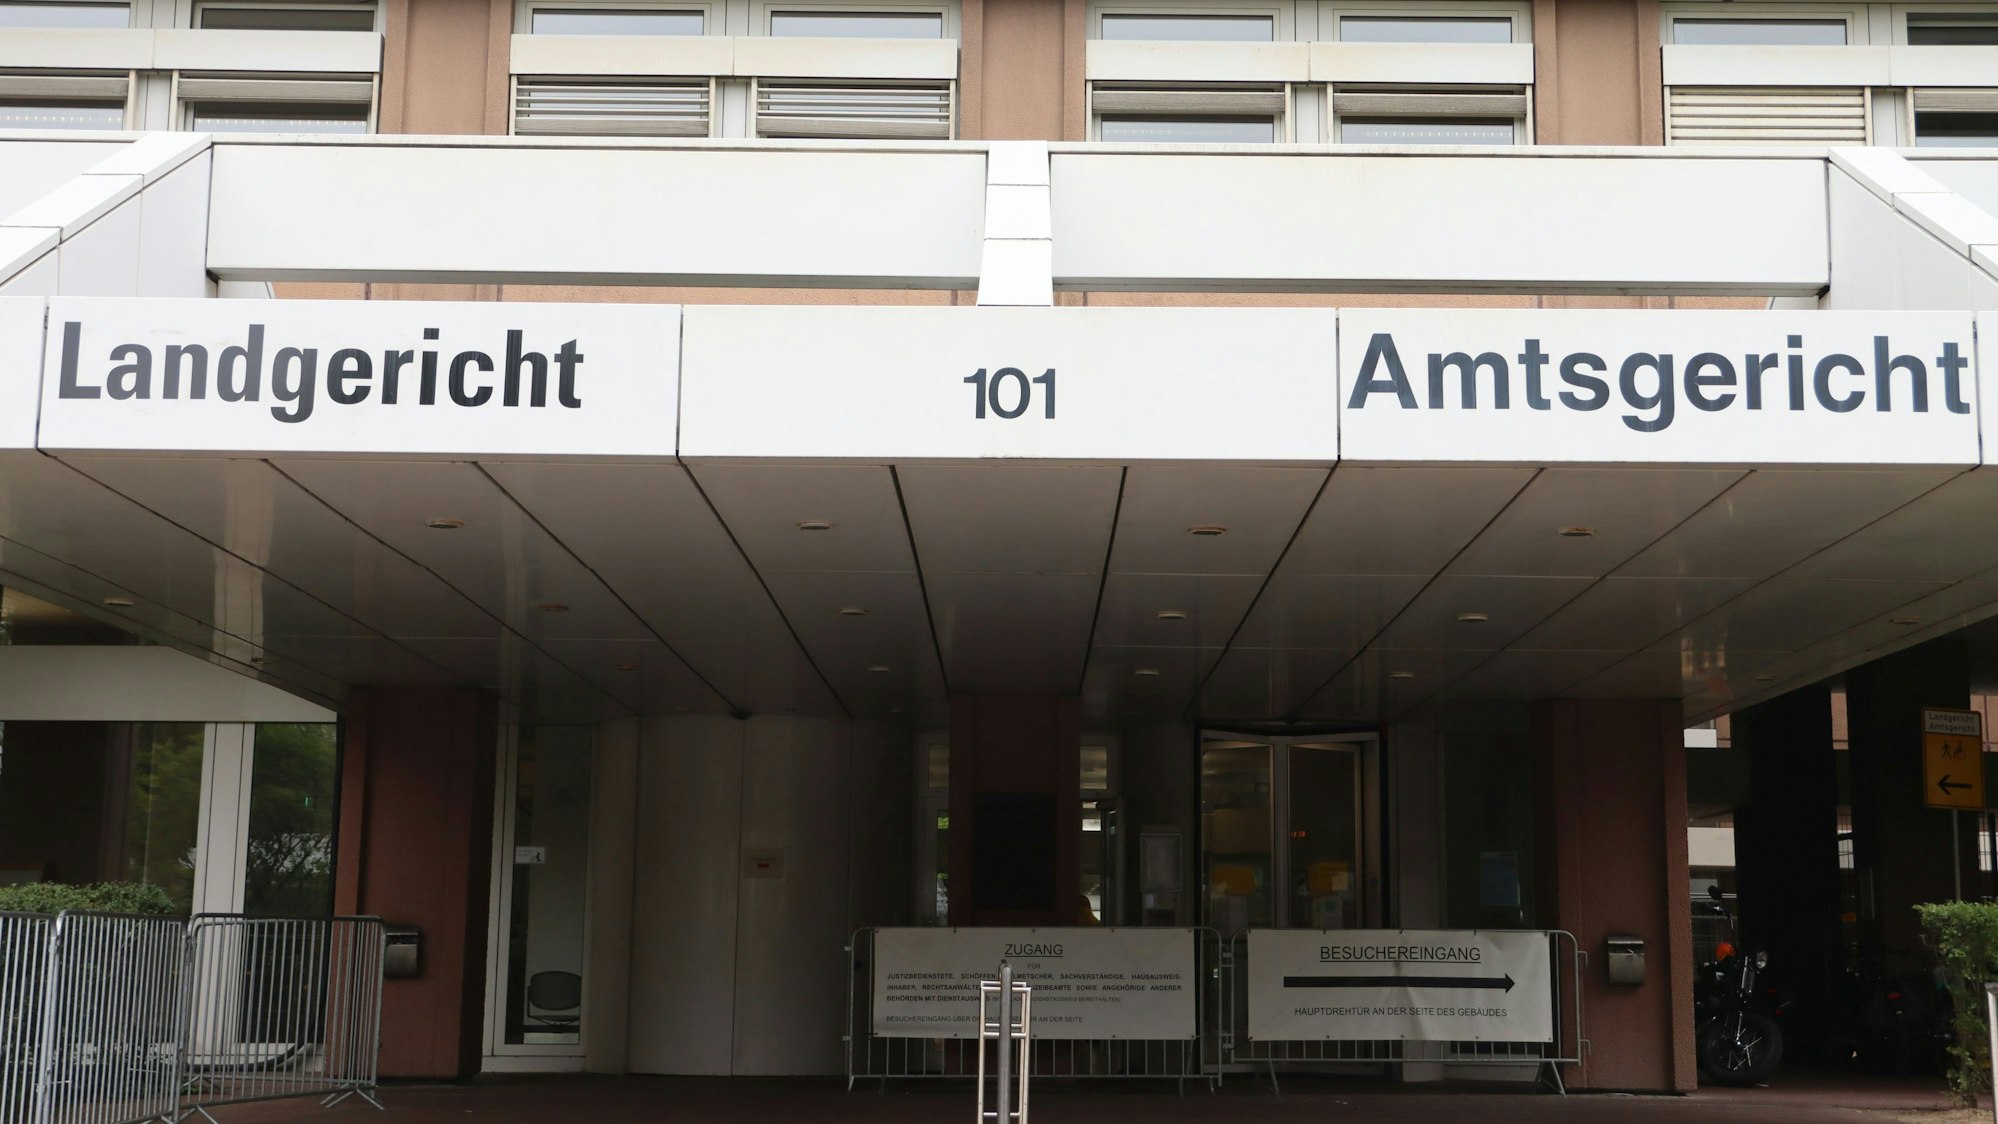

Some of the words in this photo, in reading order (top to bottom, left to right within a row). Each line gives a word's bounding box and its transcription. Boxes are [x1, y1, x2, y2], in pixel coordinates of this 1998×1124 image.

[59, 322, 583, 423] Landgericht
[1348, 334, 1969, 432] Amtsgericht
[964, 368, 1055, 418] 101
[1929, 712, 1974, 723] Landgericht
[1928, 722, 1975, 733] Amtsgericht
[1005, 943, 1064, 956] ZUGANG
[1320, 946, 1481, 961] BESUCHEREINGANG
[1102, 983, 1146, 991] ANGEHÖRIGE
[887, 994, 923, 1002] BEHÖRDEN
[1295, 1007, 1370, 1016] HAUPTDREHTÜR
[1372, 1007, 1386, 1016] AN
[1388, 1007, 1407, 1016] DER
[1409, 1007, 1435, 1016] SEITE
[1437, 1008, 1455, 1016] DES
[1457, 1007, 1507, 1017] GEBÄUDES
[952, 1014, 972, 1022] ÜBER
